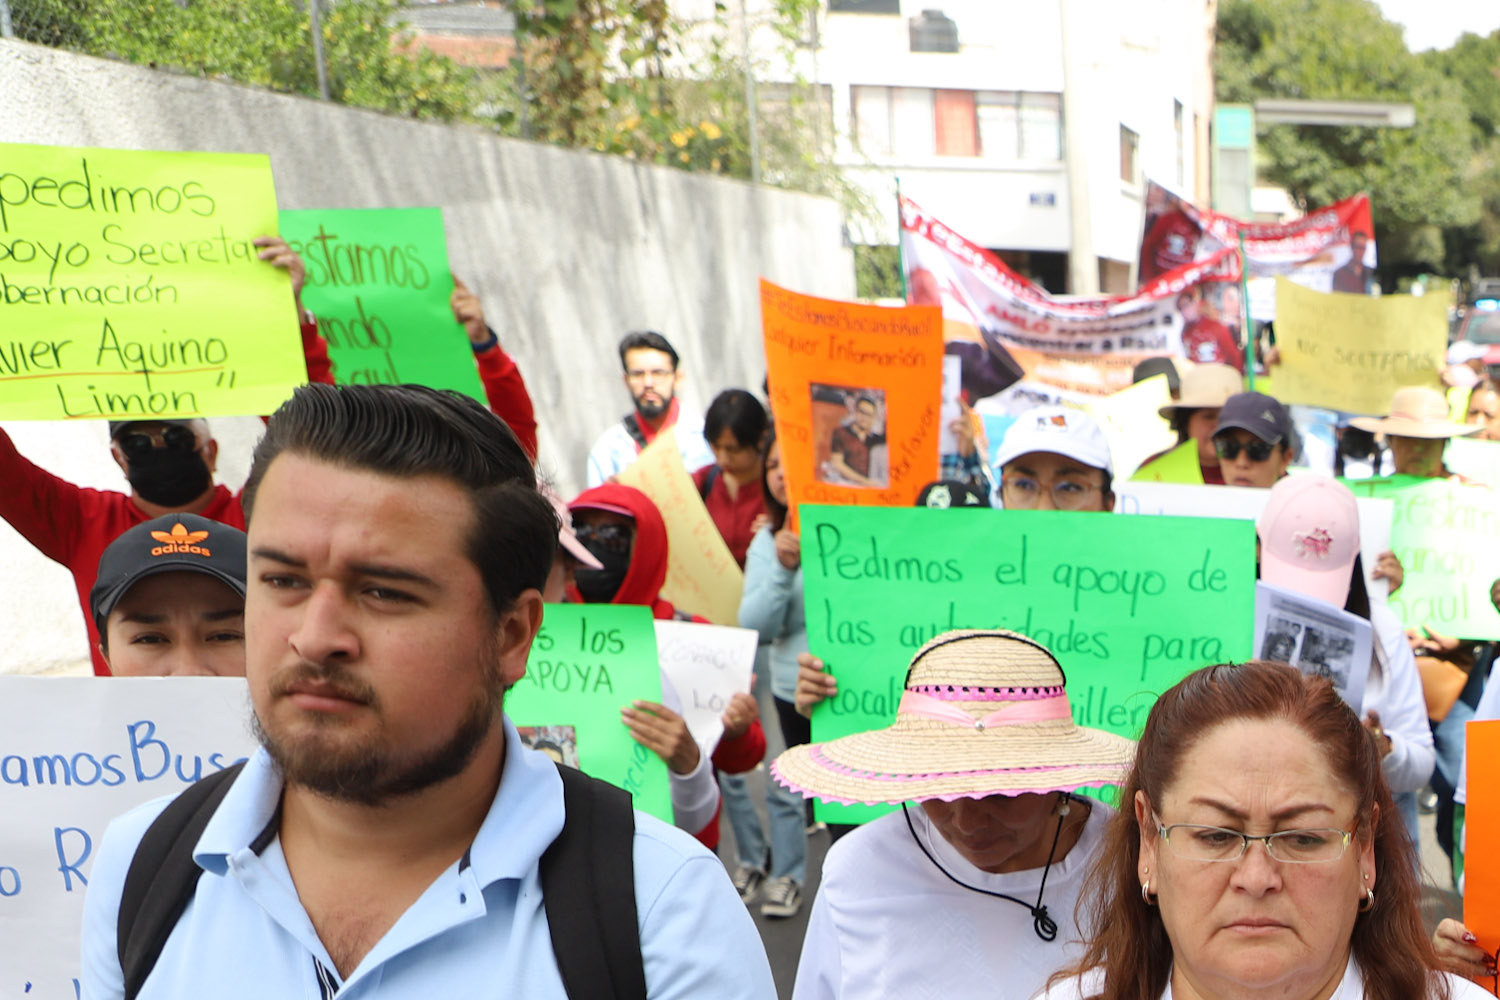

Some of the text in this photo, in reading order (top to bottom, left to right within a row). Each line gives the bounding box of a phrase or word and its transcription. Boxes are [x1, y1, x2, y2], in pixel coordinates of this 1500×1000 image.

[102, 224, 262, 266] Secreta
[0, 273, 178, 305] bernación
[97, 317, 228, 391] Aquino
[151, 544, 211, 557] adidas
[816, 522, 1228, 617] Pedimos el apoyo de
[824, 598, 876, 647] las
[1143, 632, 1223, 682] para
